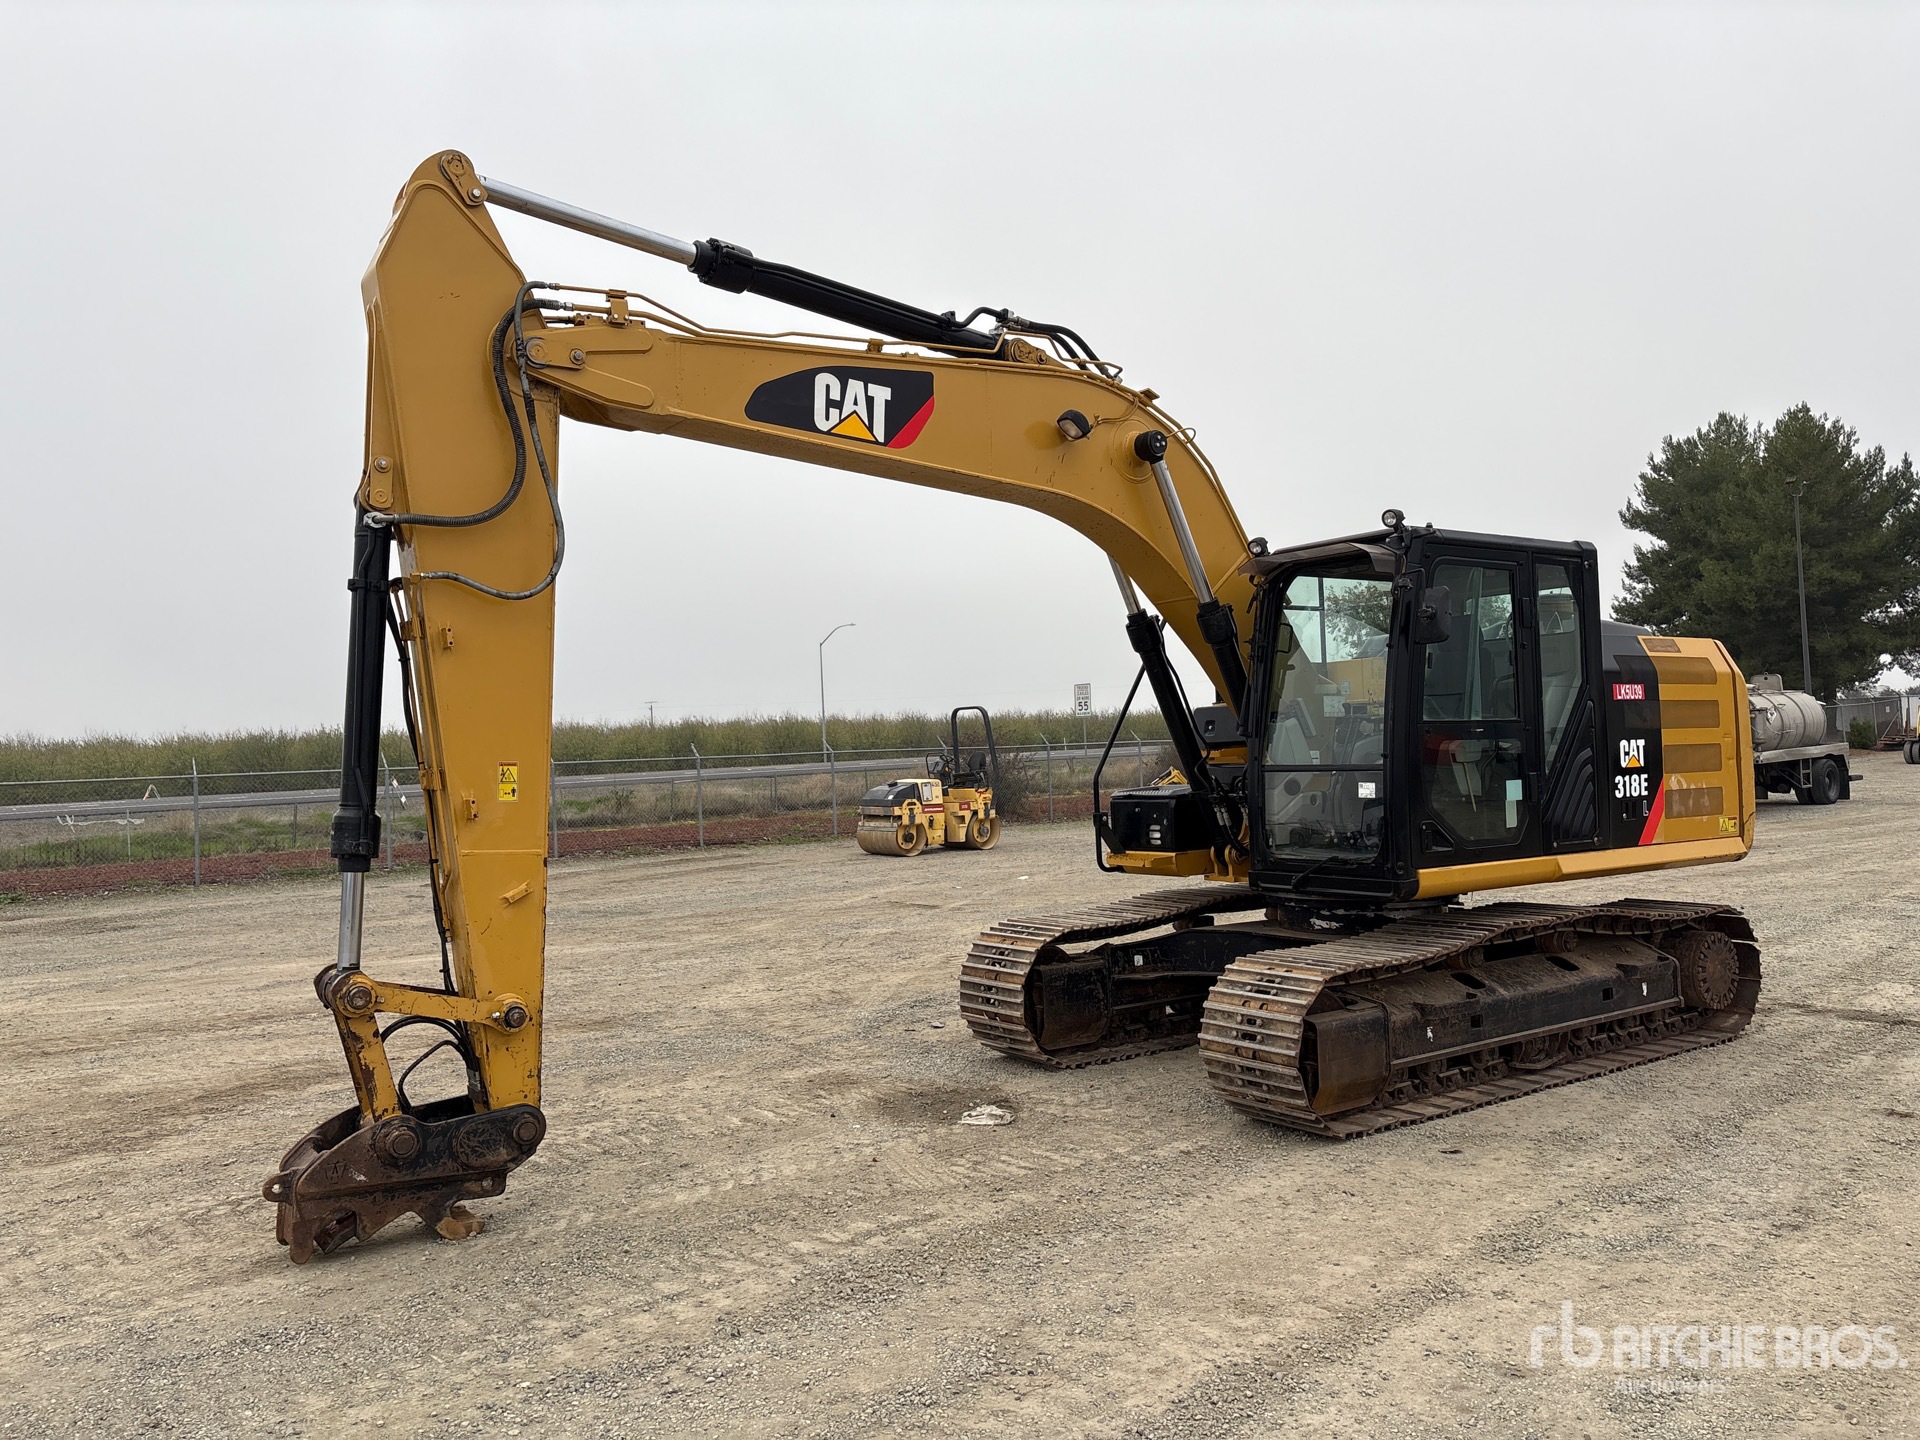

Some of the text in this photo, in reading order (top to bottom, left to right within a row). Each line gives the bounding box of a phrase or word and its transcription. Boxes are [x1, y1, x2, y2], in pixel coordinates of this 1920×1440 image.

[814, 372, 891, 443] CAT
[1616, 684, 1642, 699] LK5U39
[1078, 701, 1089, 711] 55
[1619, 739, 1645, 768] CAT
[1614, 774, 1648, 798] 318E
